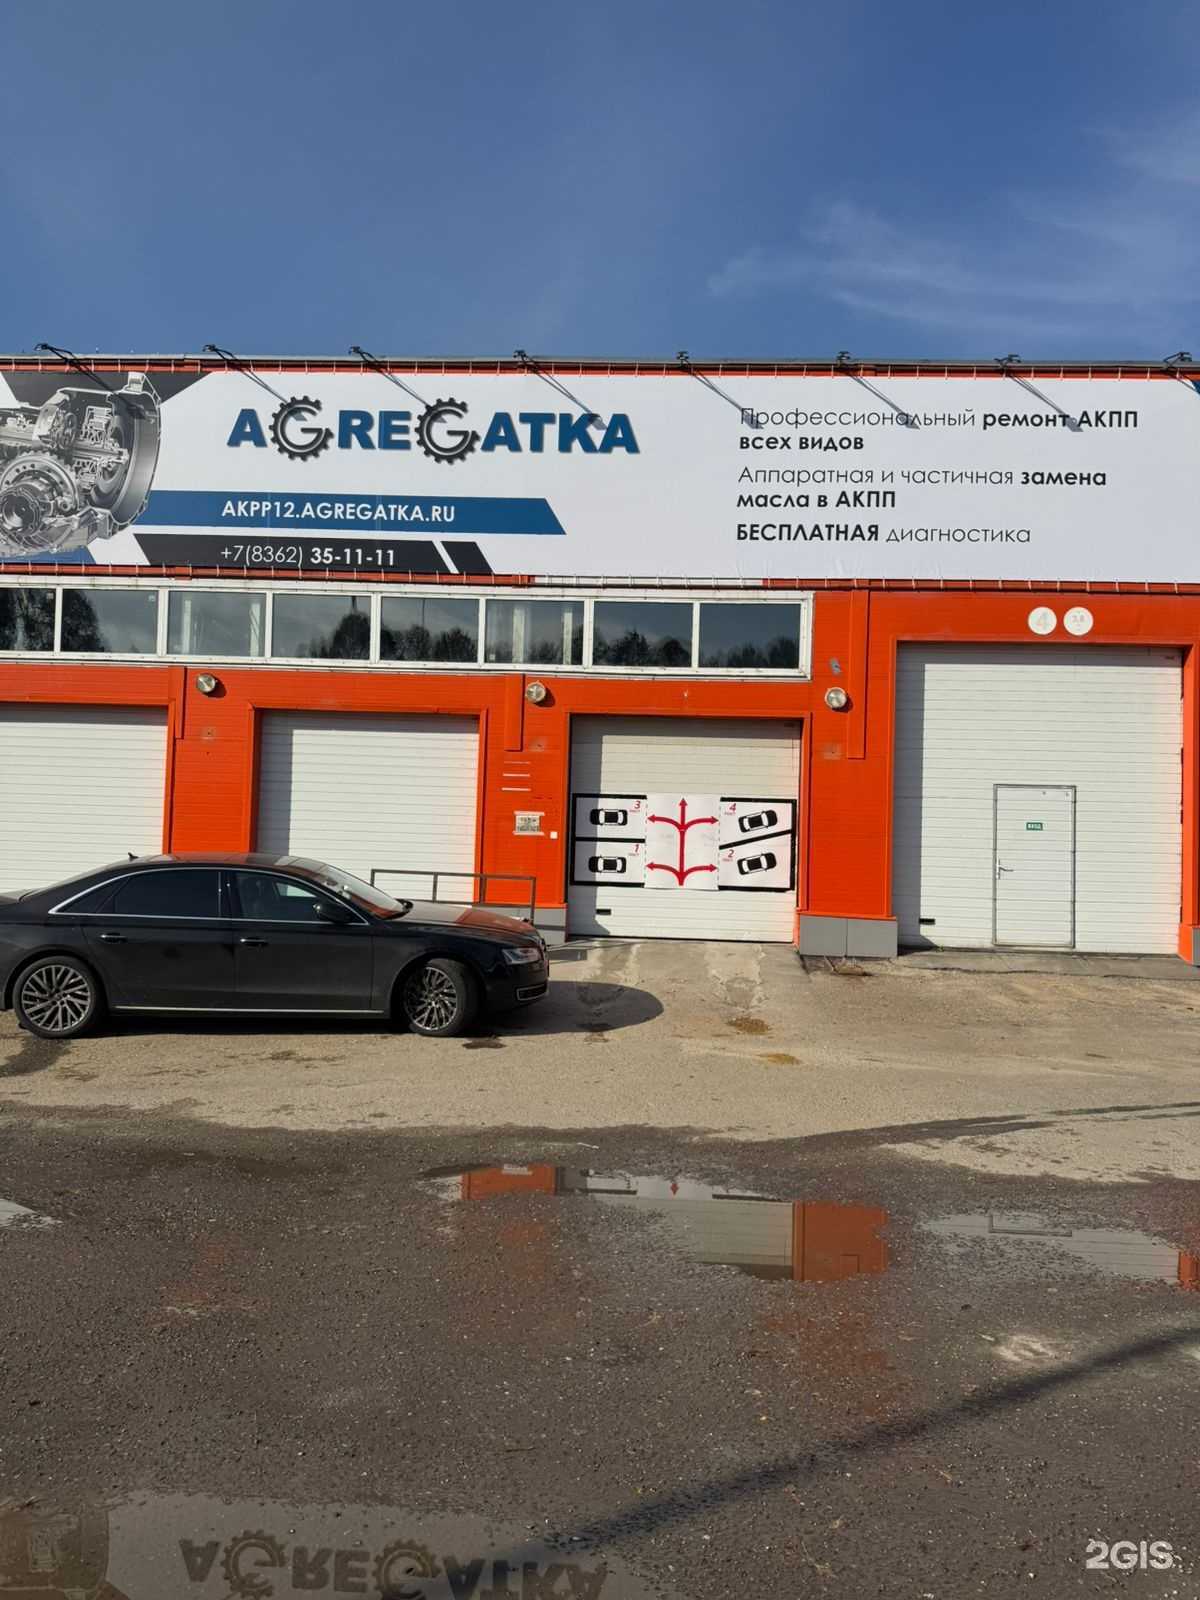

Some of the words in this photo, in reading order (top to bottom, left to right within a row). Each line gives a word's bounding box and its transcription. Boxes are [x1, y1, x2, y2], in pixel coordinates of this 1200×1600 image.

[740, 408, 976, 429] Профессиональный
[983, 412, 1069, 430] ремонт
[1078, 411, 1138, 428] АКПП
[227, 395, 640, 466] AGREGATKA
[739, 437, 792, 450] всех
[799, 437, 865, 452] видов
[738, 467, 874, 487] Аппаратная
[882, 470, 895, 484] и
[901, 471, 1014, 485] частичная
[1021, 471, 1108, 486] замена
[737, 495, 810, 508] масла
[817, 495, 828, 508] в
[835, 490, 897, 508] АКПП
[221, 500, 456, 523] AKPP12.AGREGATKA.RU
[736, 524, 880, 542] БЕСПЛАТНАЯ
[886, 526, 1032, 544] диагностика
[220, 545, 303, 566] +7(8362)
[310, 547, 396, 568] 35-11-11
[634, 800, 641, 809] 3
[728, 802, 737, 812] 4
[727, 849, 735, 858] 2
